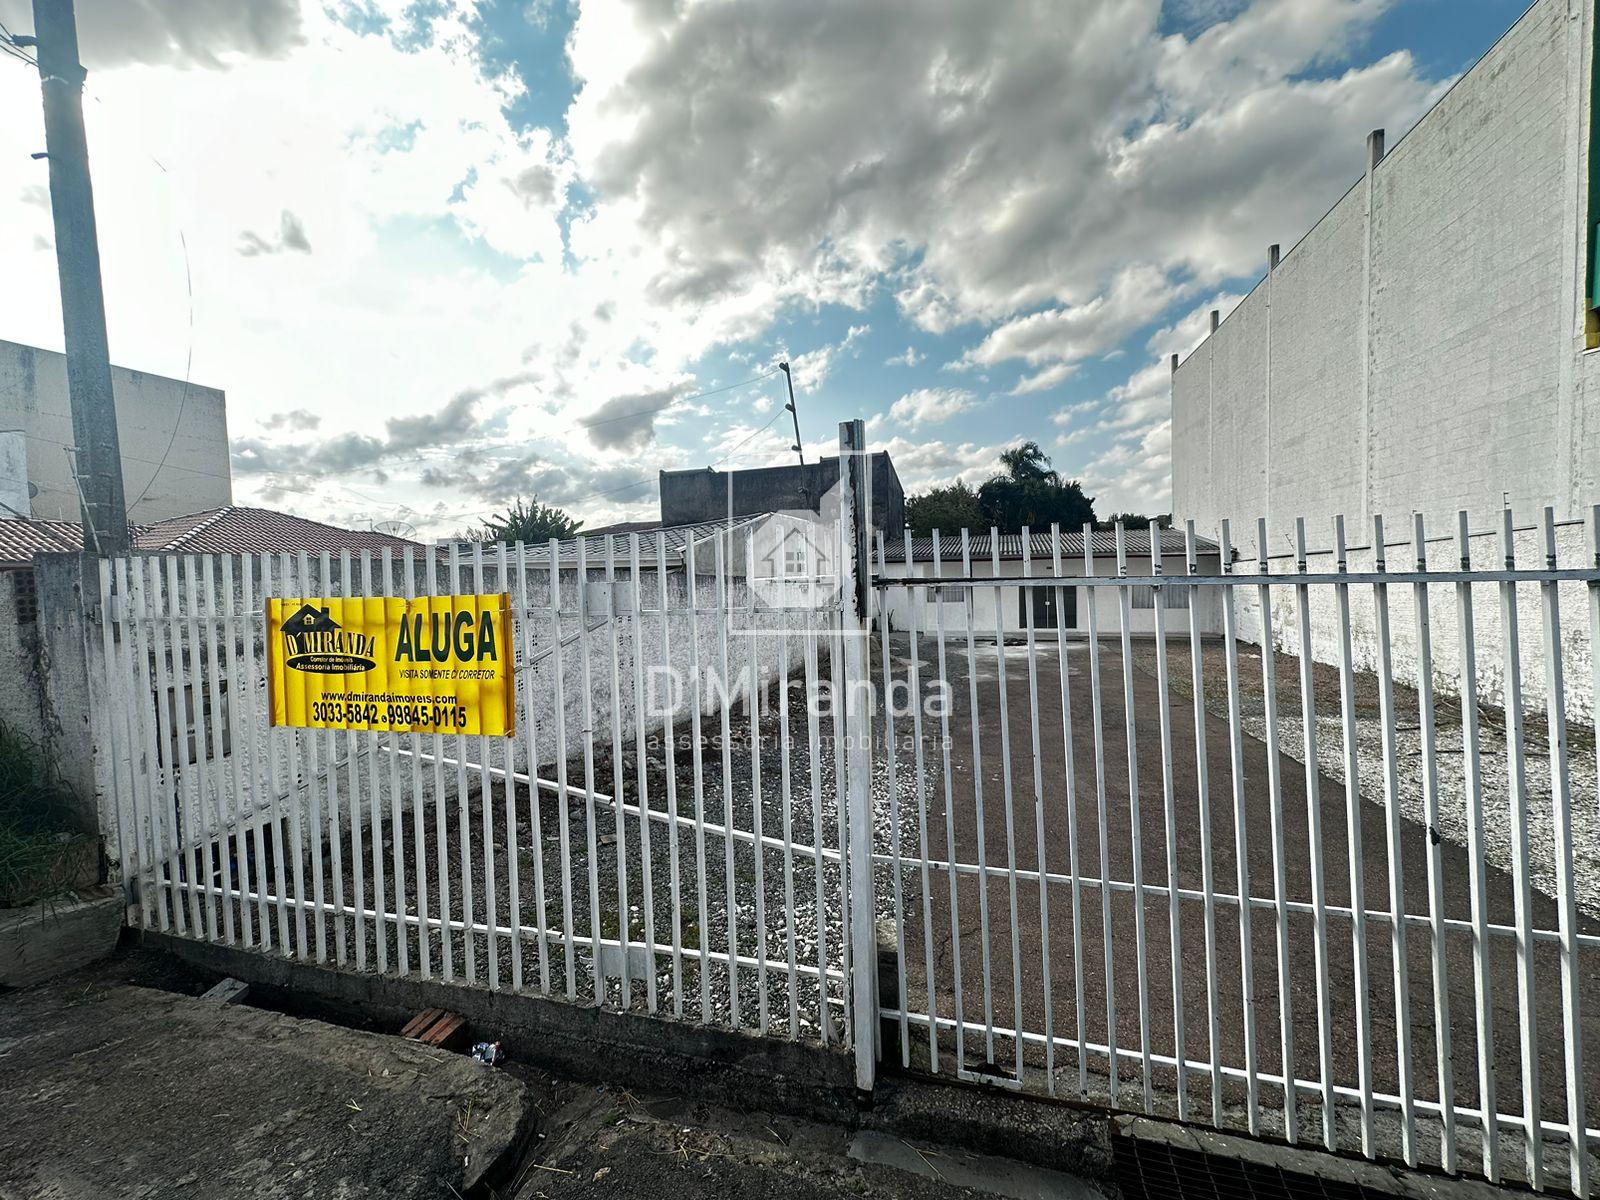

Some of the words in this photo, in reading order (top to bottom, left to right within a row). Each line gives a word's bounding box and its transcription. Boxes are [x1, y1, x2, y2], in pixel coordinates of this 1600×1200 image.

[395, 610, 498, 663] ALUGA
[331, 663, 365, 671] Imobiliária
[399, 669, 419, 679] VISITA
[419, 669, 449, 679] SOMENTE
[458, 669, 495, 680] CORRETOR
[320, 691, 457, 705] www.dmirandaimoveis.com
[312, 701, 379, 724] 3033-5842
[387, 704, 467, 728] 99845-0115
